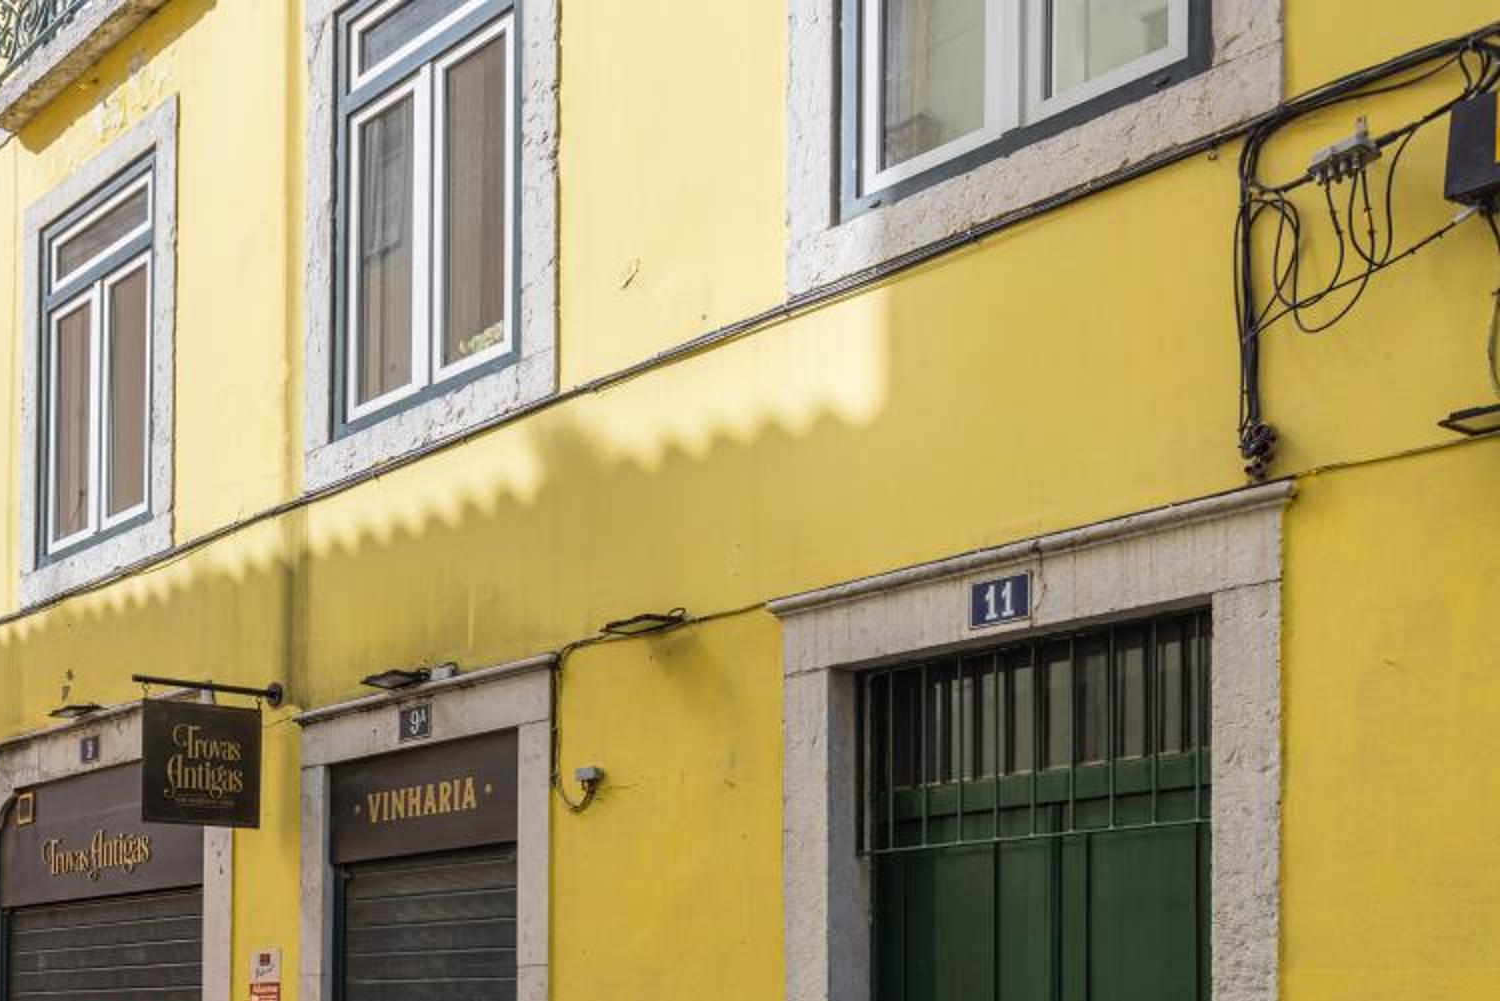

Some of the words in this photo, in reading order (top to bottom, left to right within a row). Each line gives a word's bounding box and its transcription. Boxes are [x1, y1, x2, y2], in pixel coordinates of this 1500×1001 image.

[985, 581, 1015, 621] 11
[172, 723, 241, 761] Trovas
[163, 754, 244, 798] Antigas
[367, 776, 477, 824] VINHARIA
[42, 837, 89, 875] Trovas
[87, 829, 149, 880] Antigas
